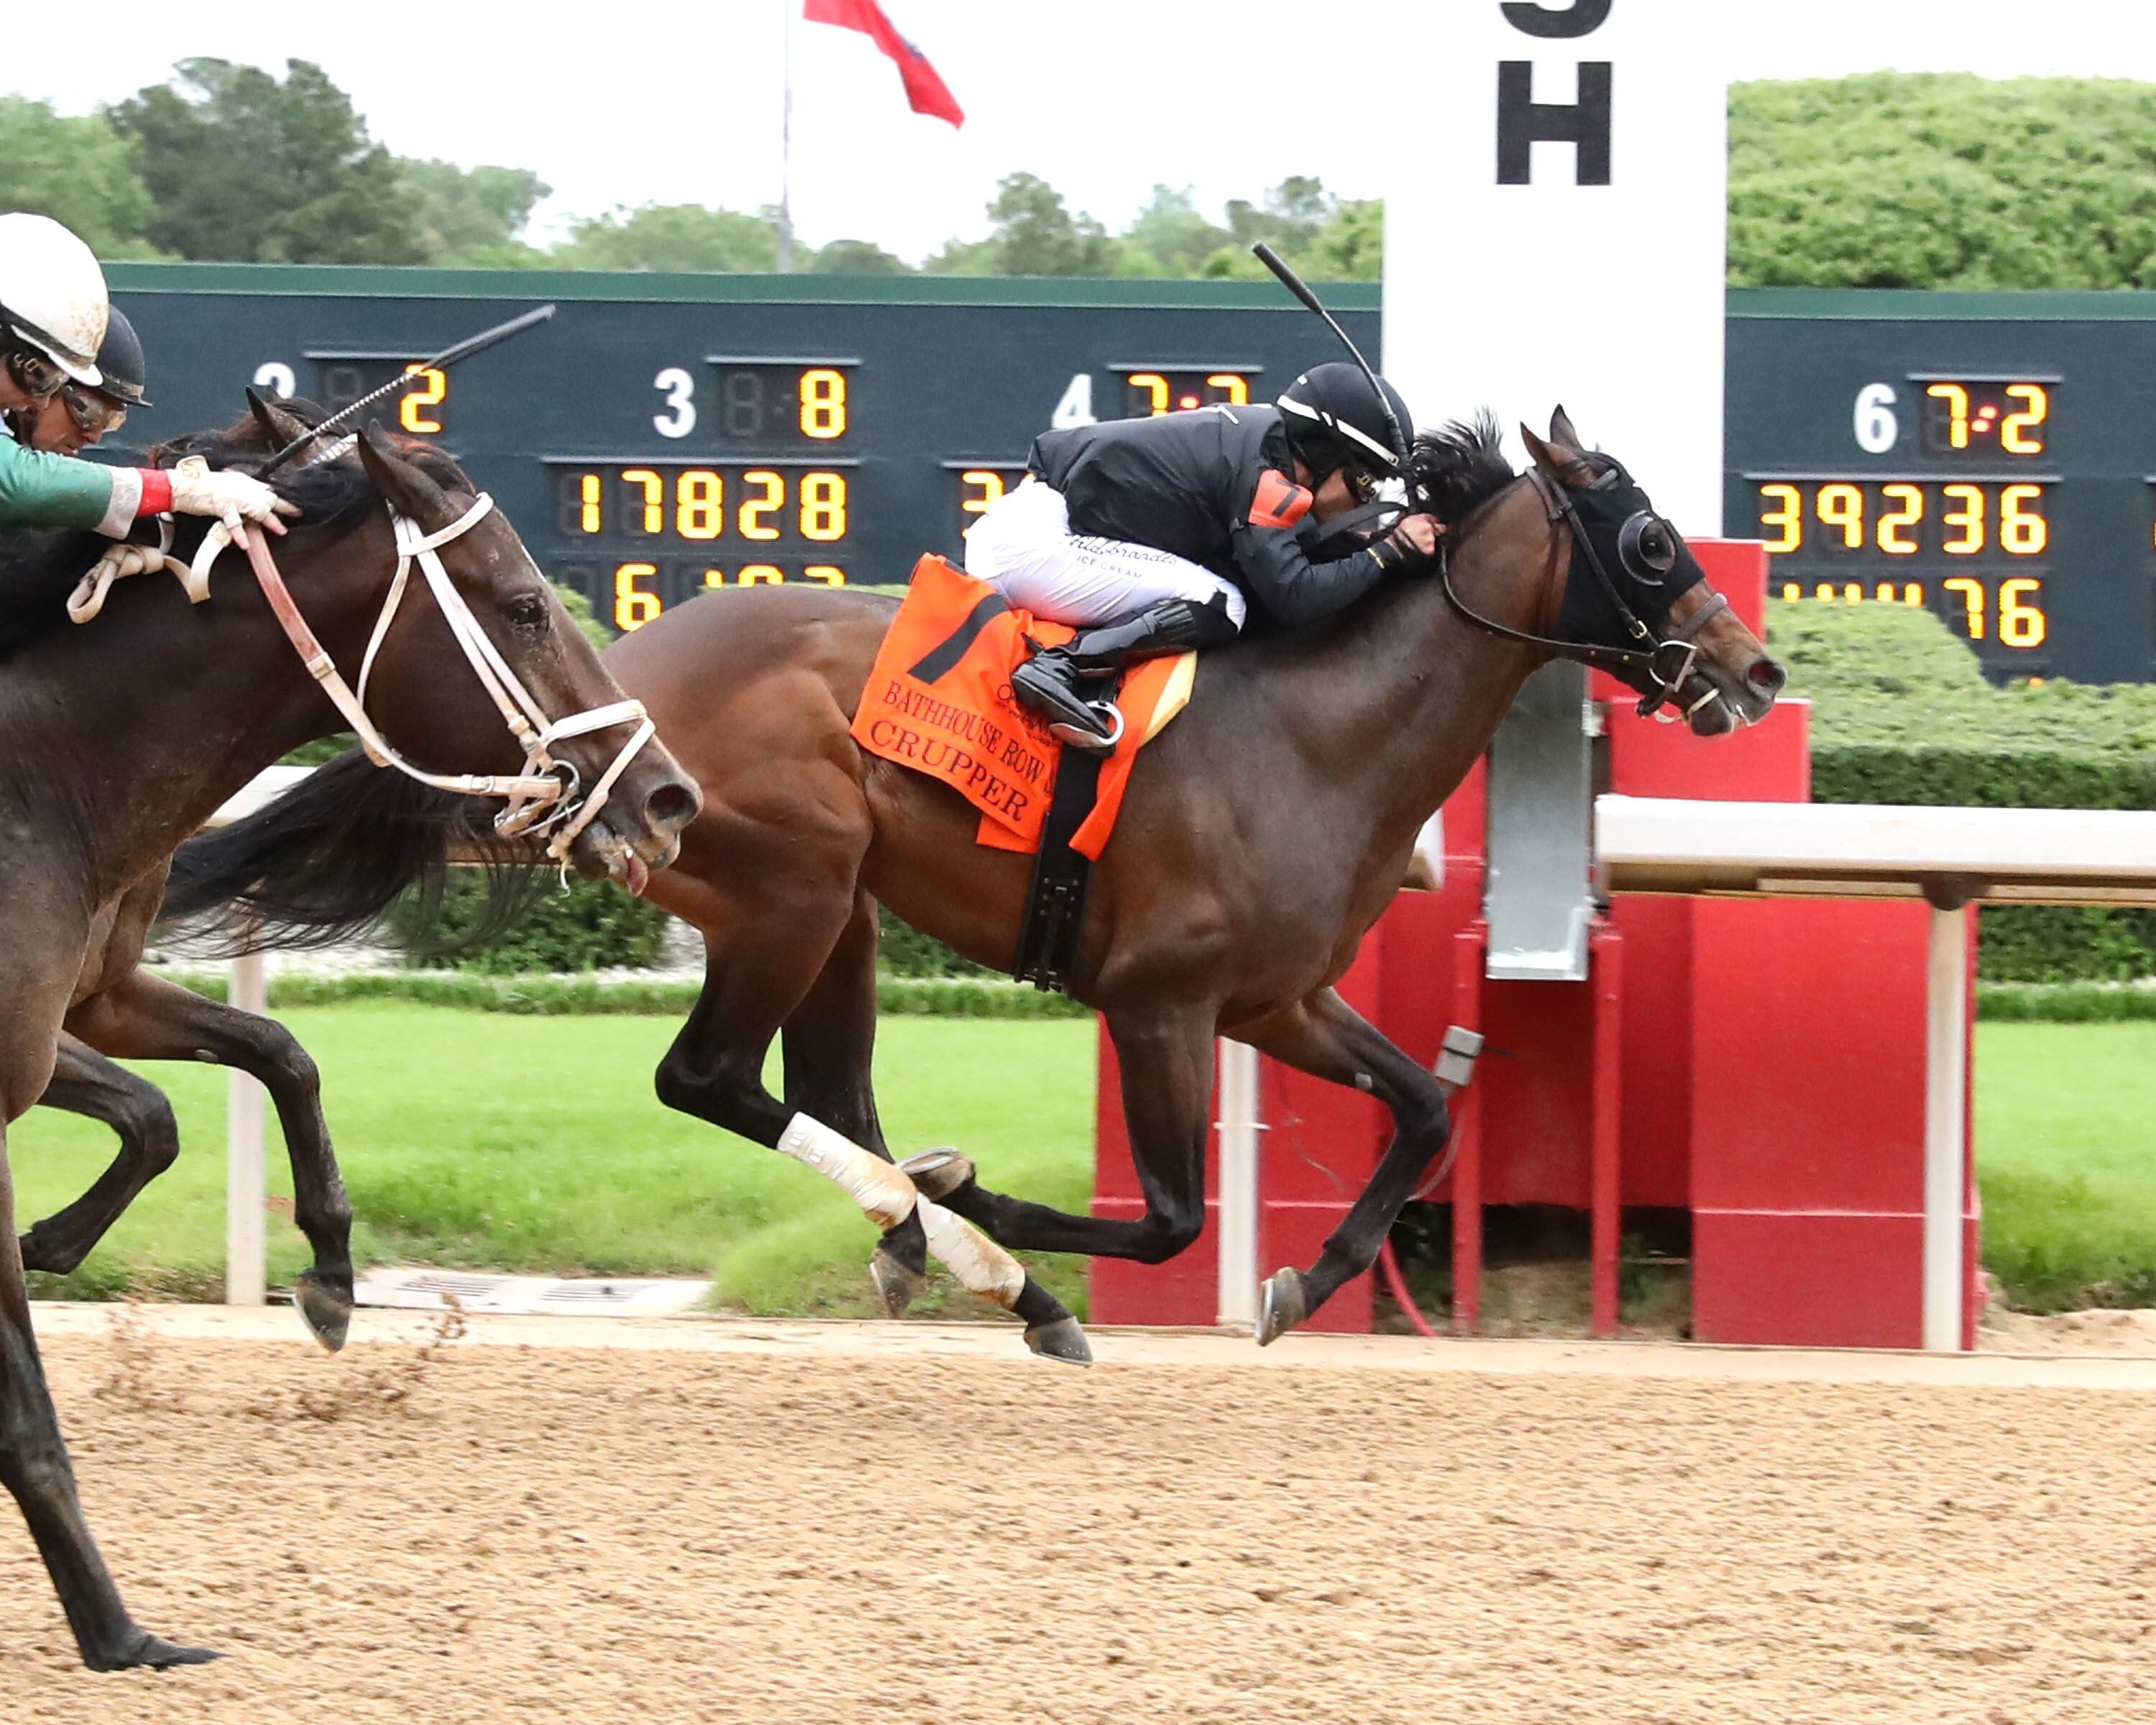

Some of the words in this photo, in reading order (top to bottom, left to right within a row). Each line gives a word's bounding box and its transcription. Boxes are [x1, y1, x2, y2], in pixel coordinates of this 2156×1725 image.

[399, 363, 446, 433] 2
[653, 368, 696, 438] 3
[798, 369, 848, 439] 8
[1051, 373, 1098, 428] 4
[1853, 383, 1898, 453] 6
[581, 469, 848, 542] 17828
[1760, 484, 2047, 555] 39236
[883, 681, 1003, 755] BATHHOUSE
[1000, 737, 1046, 783] ROW
[870, 719, 1029, 822] CRUPPER
